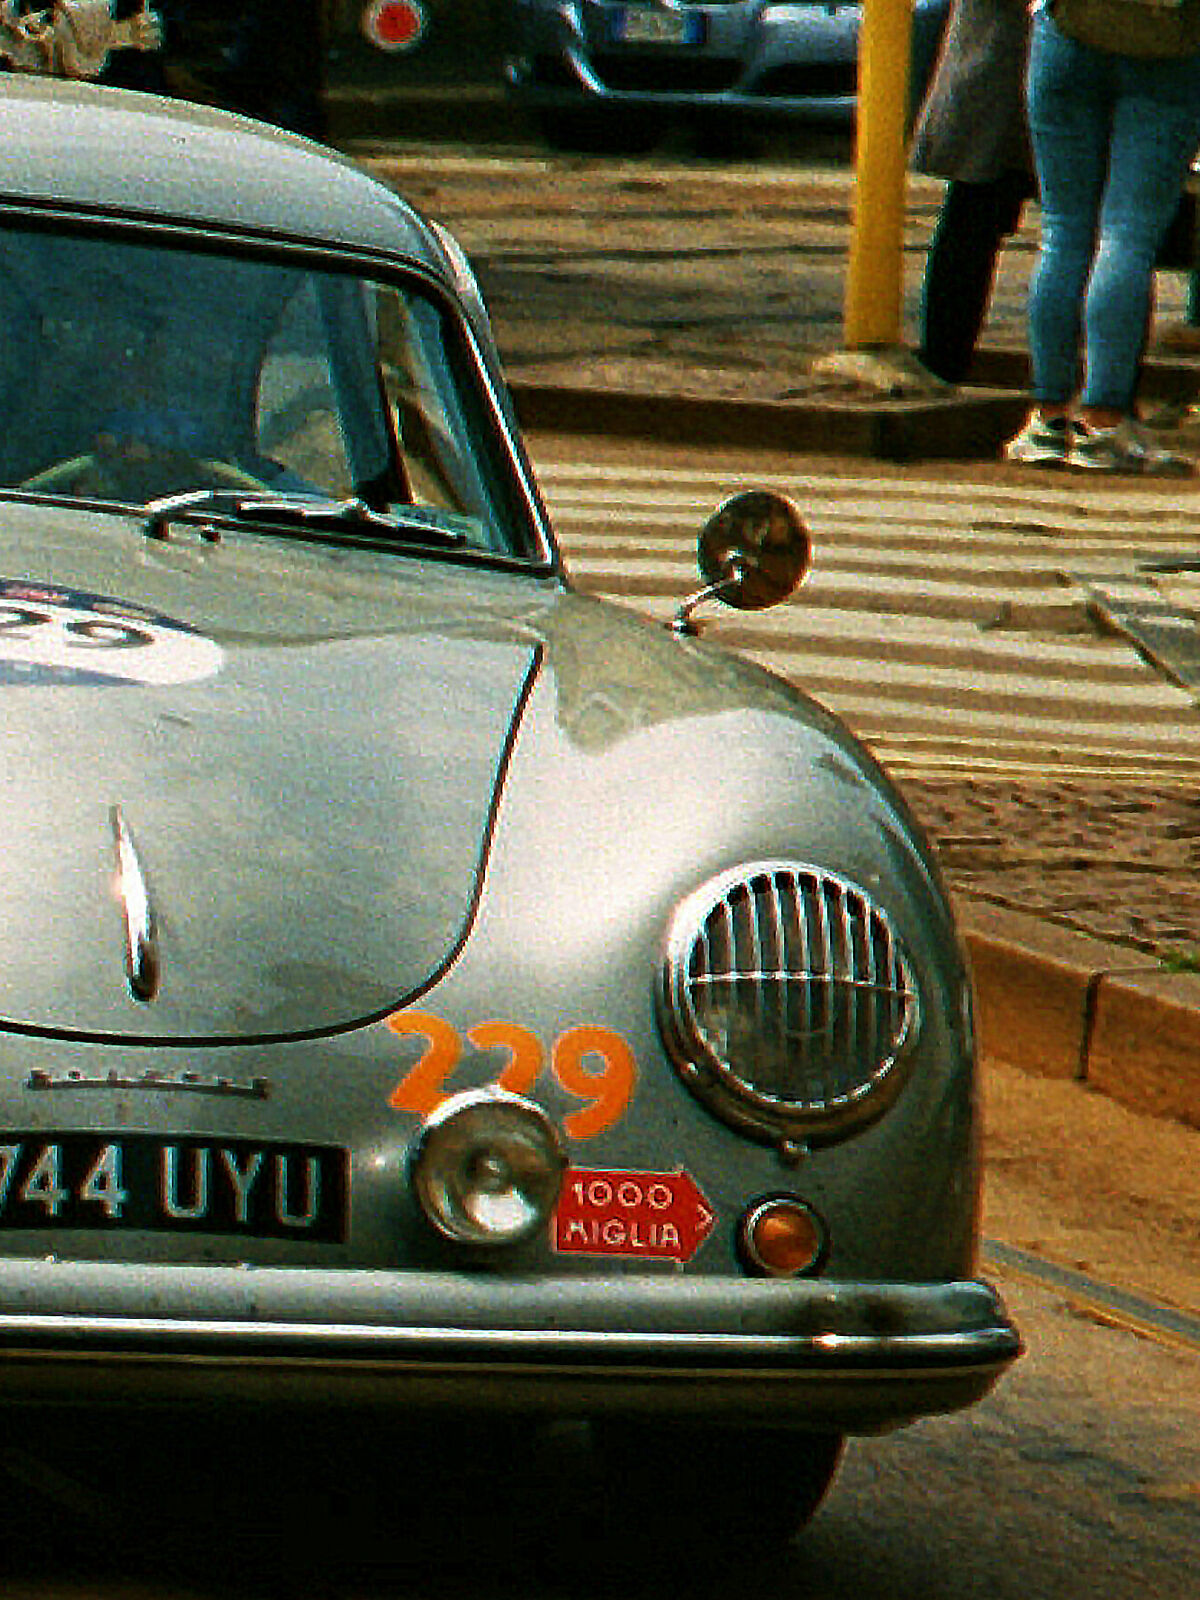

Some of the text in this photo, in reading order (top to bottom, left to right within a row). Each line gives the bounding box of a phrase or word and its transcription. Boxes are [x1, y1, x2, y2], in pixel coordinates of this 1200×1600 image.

[388, 1007, 638, 1139] 229
[163, 1145, 320, 1228] UYU
[571, 1179, 674, 1210] 1000
[564, 1218, 682, 1249] MIGLIA
